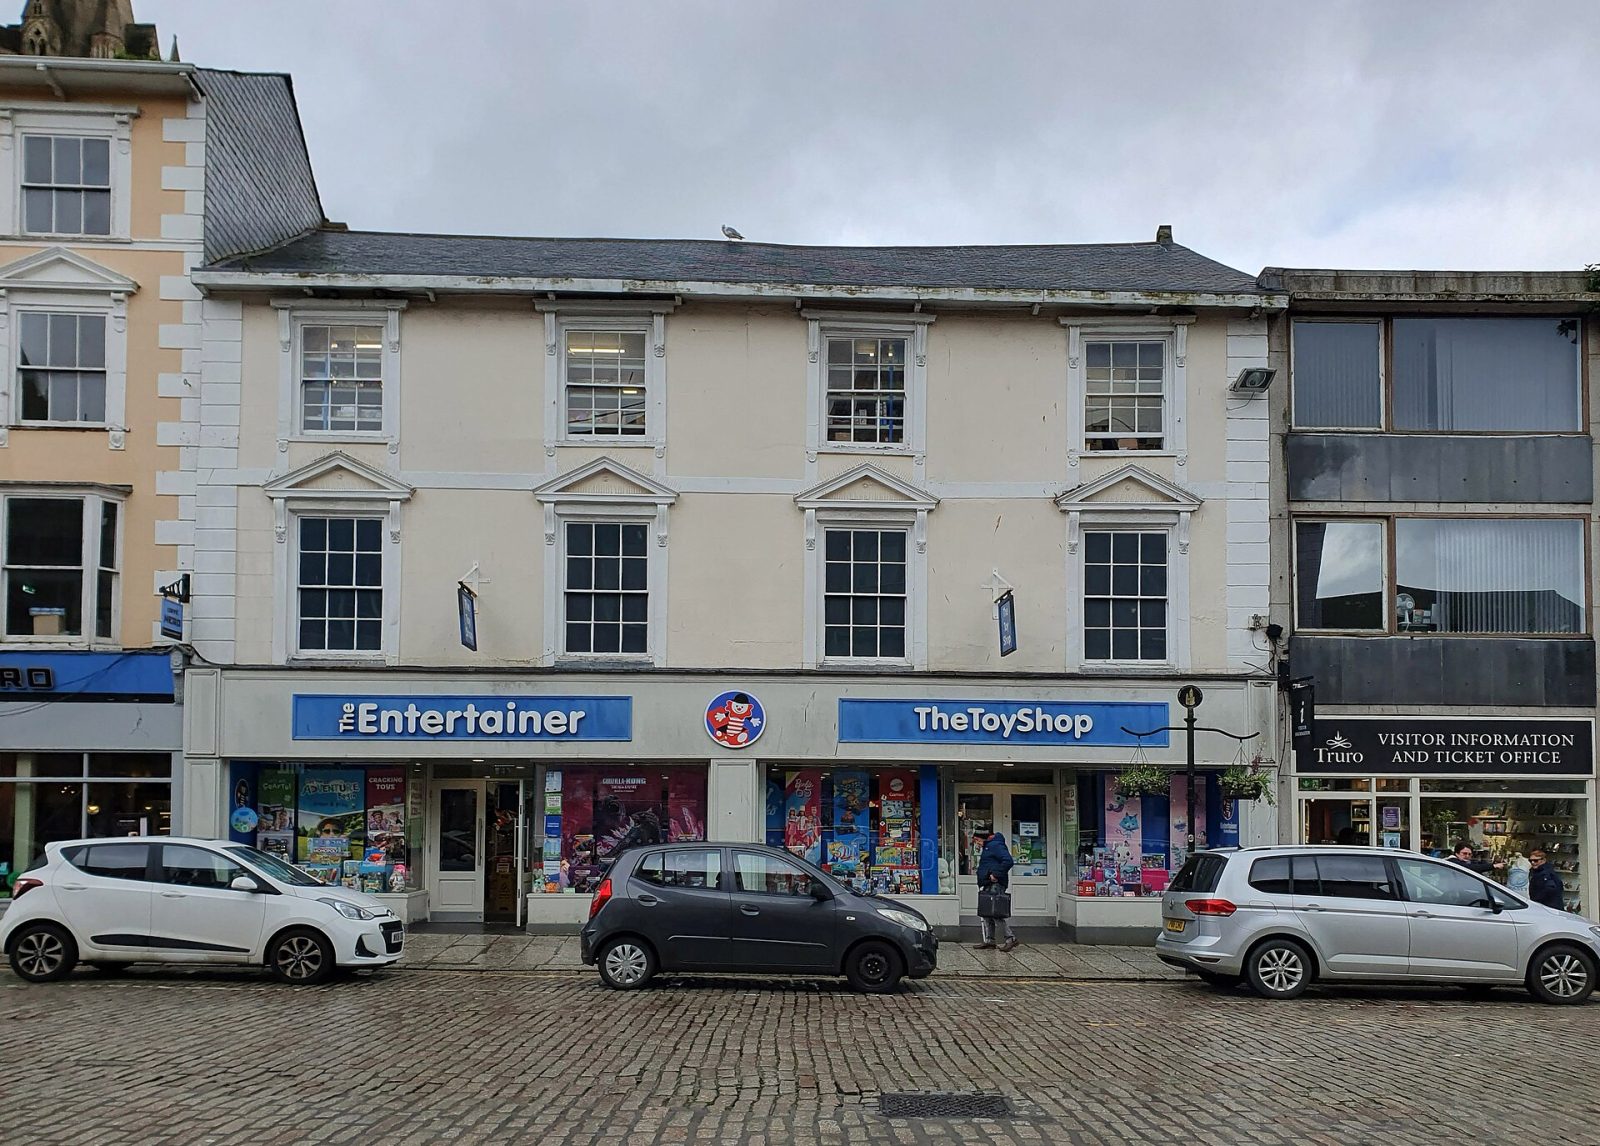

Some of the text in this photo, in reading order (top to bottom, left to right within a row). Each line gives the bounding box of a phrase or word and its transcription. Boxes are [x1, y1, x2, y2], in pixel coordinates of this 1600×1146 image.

[338, 701, 586, 735] The Entertainer
[1377, 733, 1575, 748] VISITOR INFORMATION
[1312, 747, 1364, 764] Truro
[1391, 751, 1562, 765] AND TICKET OFFICE
[304, 781, 360, 793] ADVENTURE
